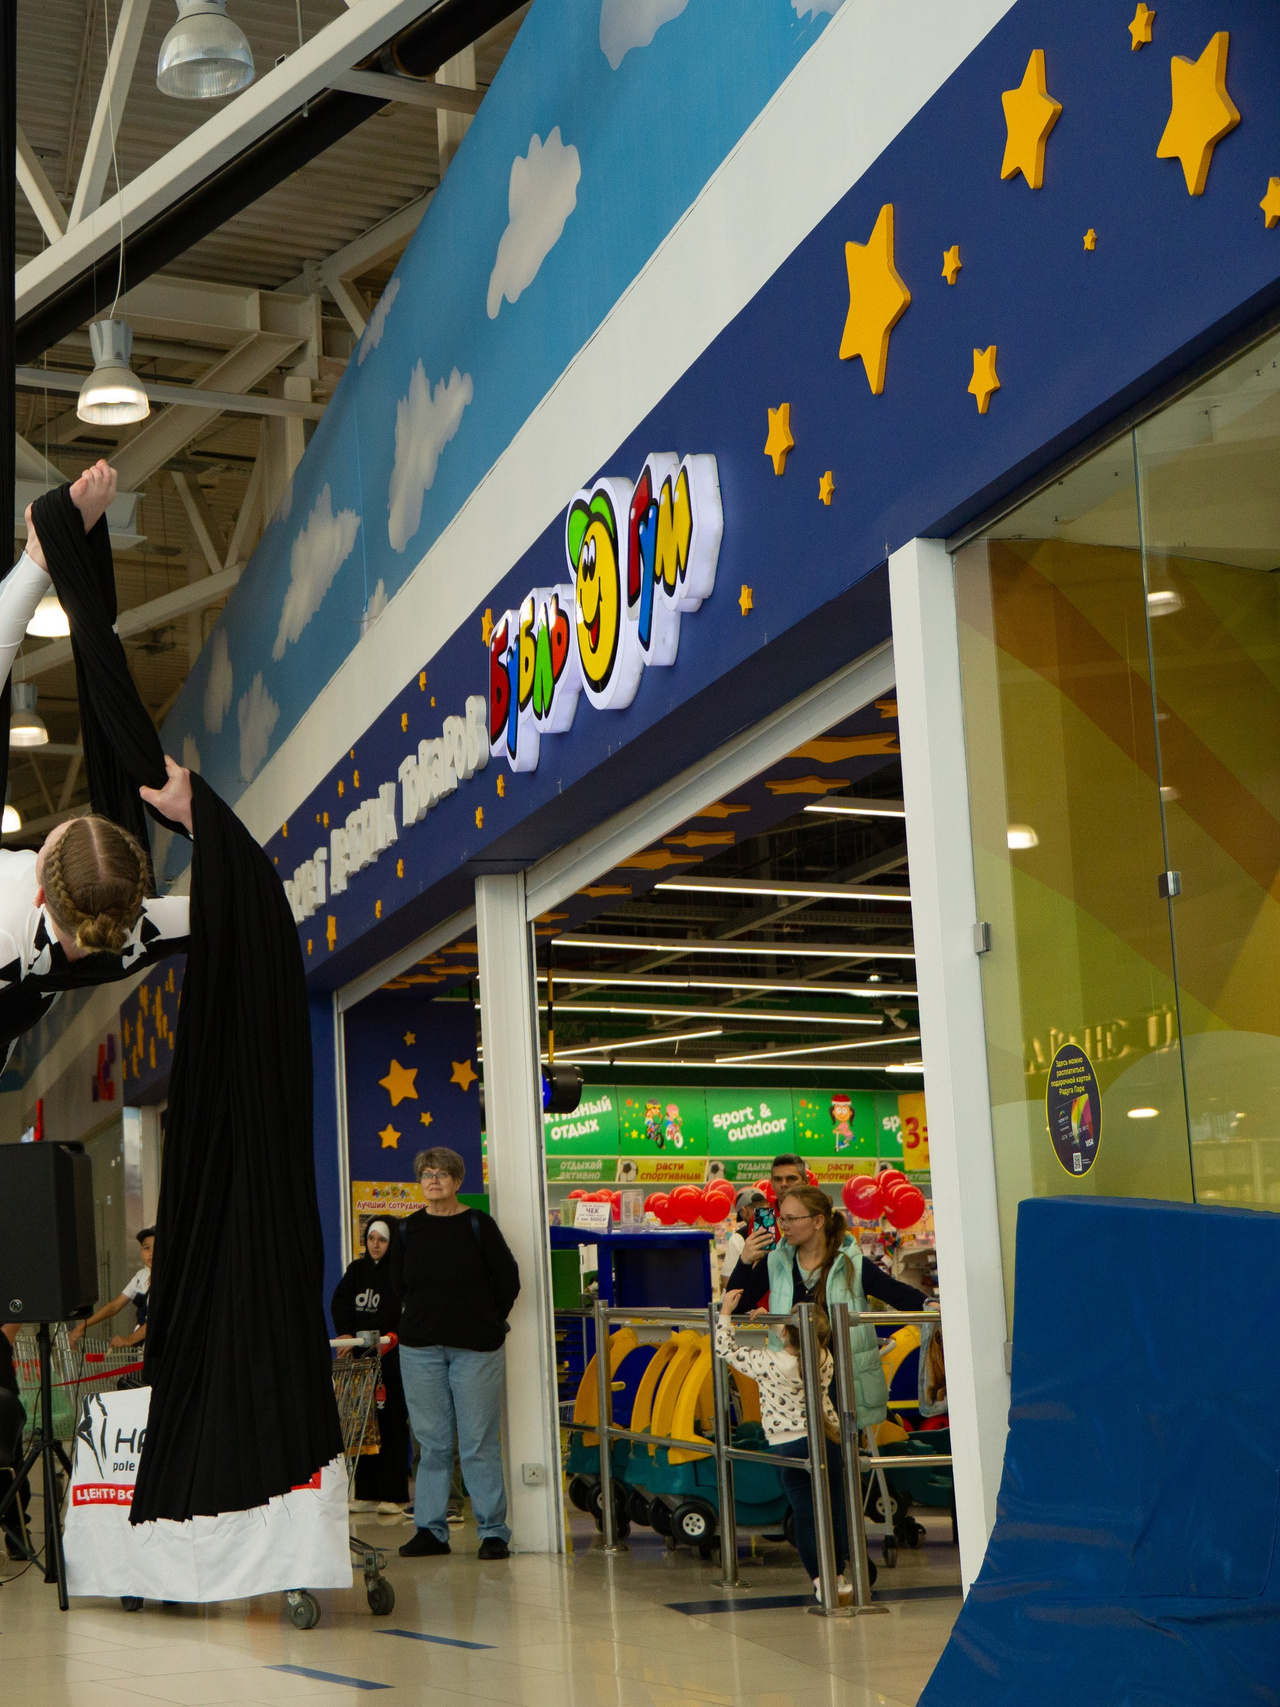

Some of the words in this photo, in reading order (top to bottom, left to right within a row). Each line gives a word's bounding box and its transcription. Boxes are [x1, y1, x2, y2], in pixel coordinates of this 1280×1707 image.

[712, 1107, 753, 1130] sport
[551, 1118, 600, 1140] ОТДЫХ
[728, 1117, 787, 1142] outdoor
[737, 1163, 772, 1171] отдыха
[113, 1461, 135, 1473] pole
[76, 1488, 116, 1502] ЦЕНТР
